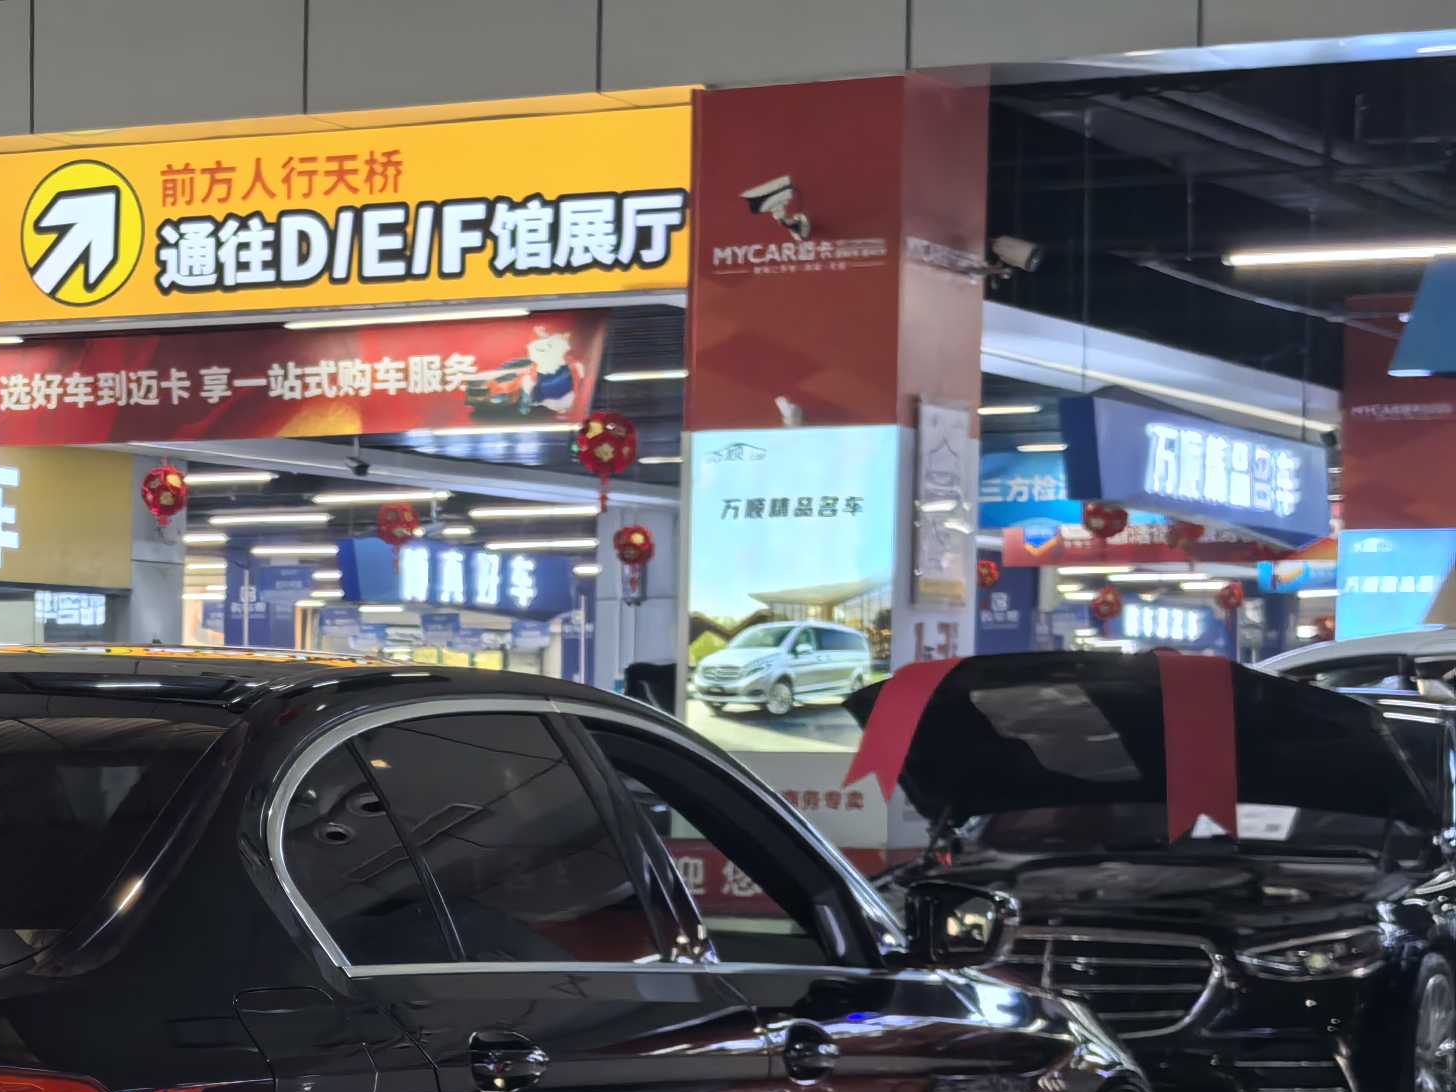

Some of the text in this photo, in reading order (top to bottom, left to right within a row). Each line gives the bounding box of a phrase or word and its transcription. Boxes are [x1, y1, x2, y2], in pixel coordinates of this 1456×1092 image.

[159, 149, 403, 206] 前方人行天桥
[159, 193, 685, 290] 通往D/E/F馆展厅
[198, 353, 478, 405] 享一站式购车服务
[977, 474, 1068, 503] 三方检
